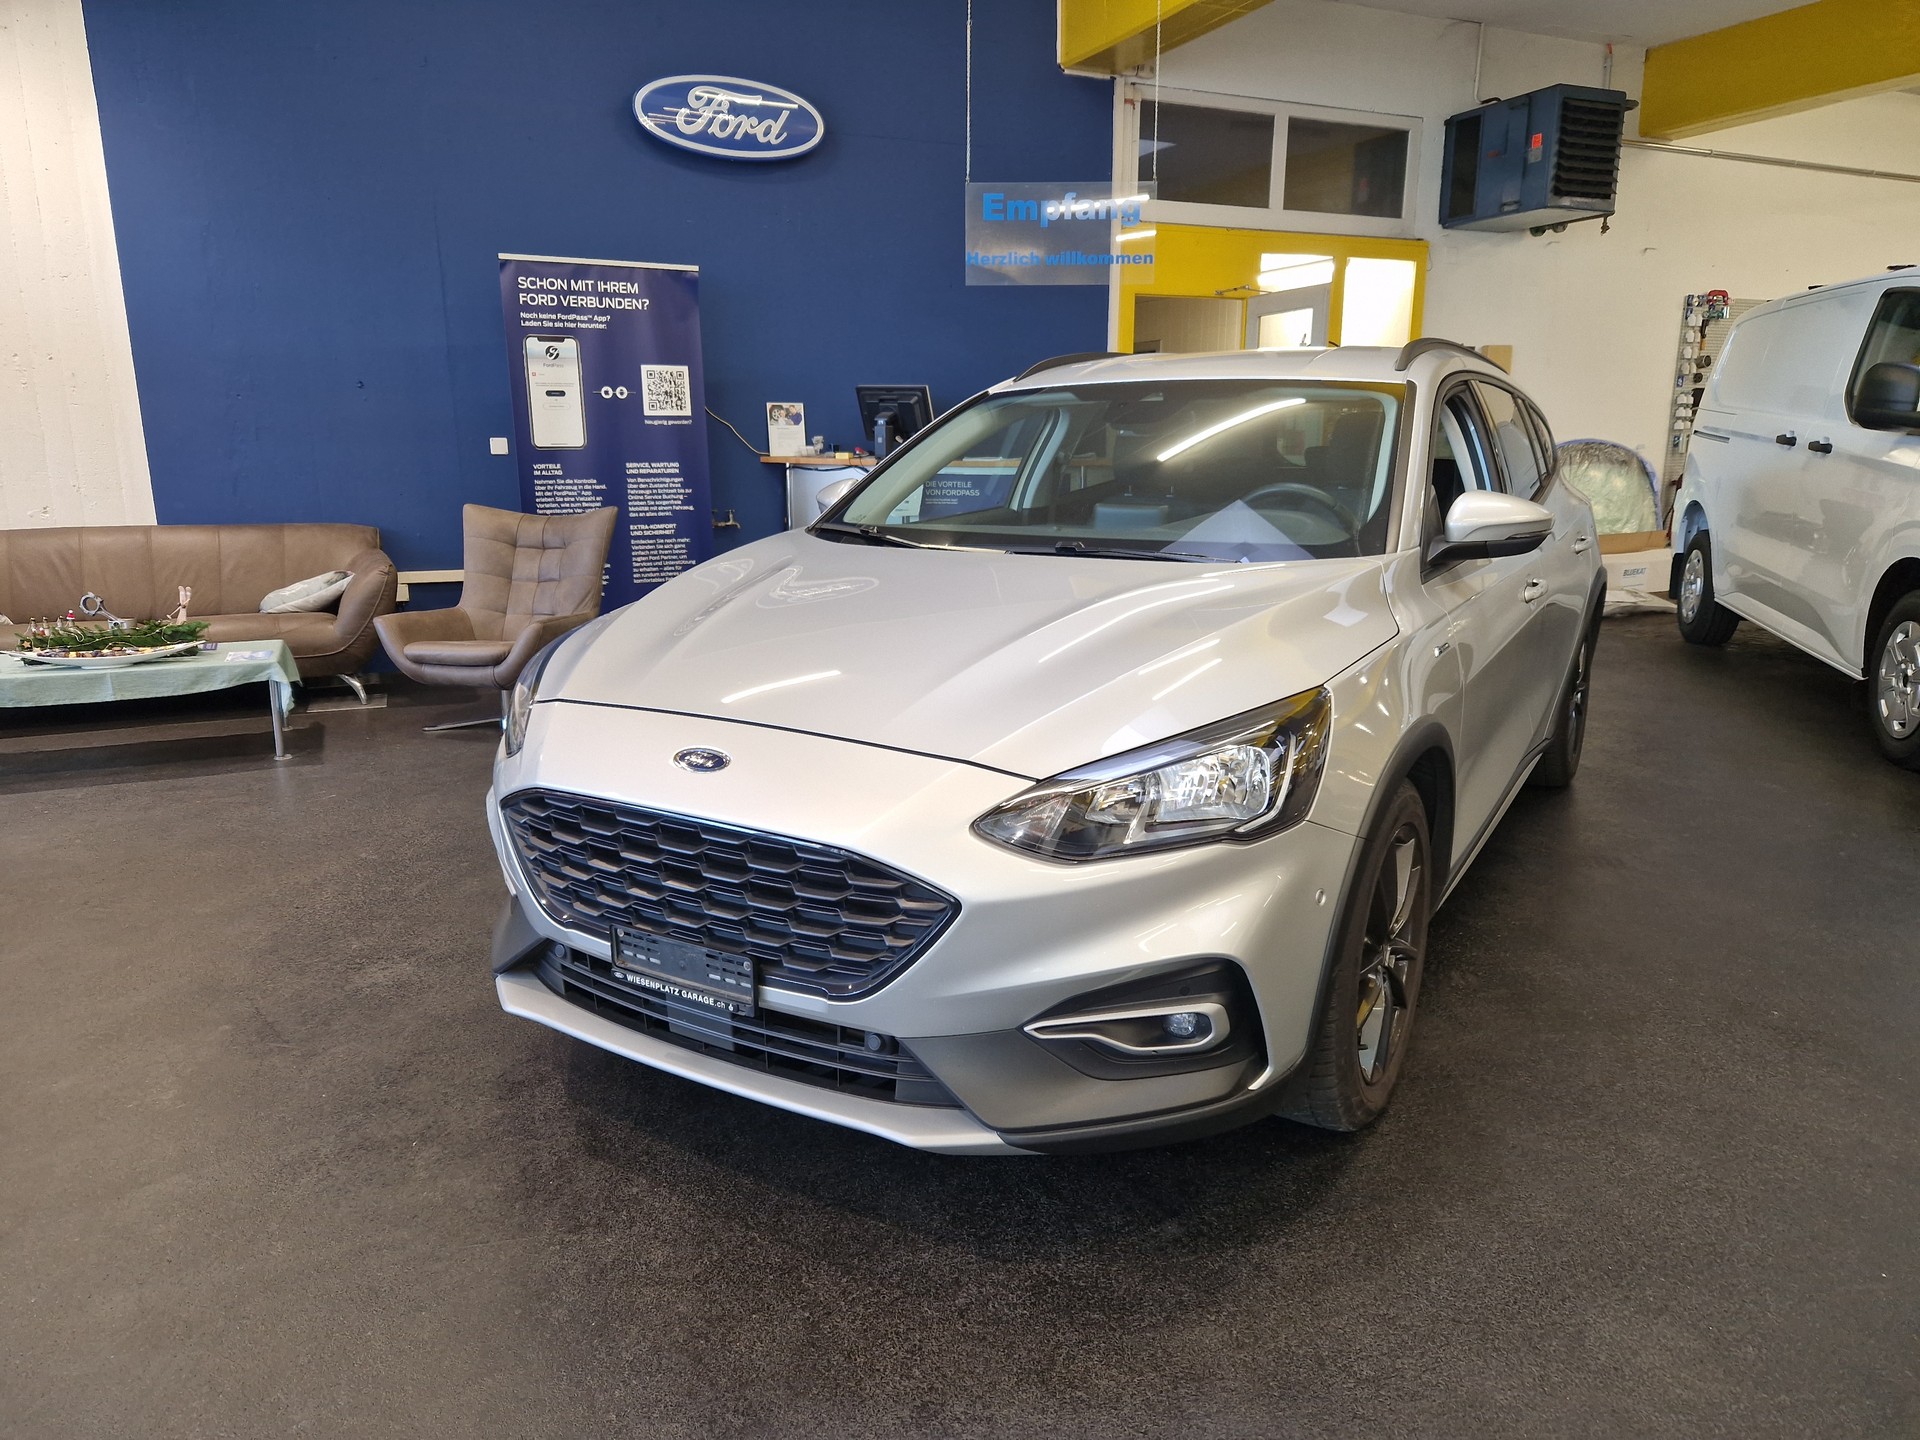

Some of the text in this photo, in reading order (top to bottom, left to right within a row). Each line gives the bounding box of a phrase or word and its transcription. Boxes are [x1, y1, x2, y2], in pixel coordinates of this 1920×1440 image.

[676, 86, 790, 145] Ford
[982, 192, 1141, 228] Empfang
[965, 251, 1154, 267] Herzlich willkommen
[517, 277, 639, 294] SCHON MIT IHREM
[518, 293, 650, 310] FORD VERBUNDEN?
[626, 974, 726, 1009] WIESENPLATZ GARAGE.ch
